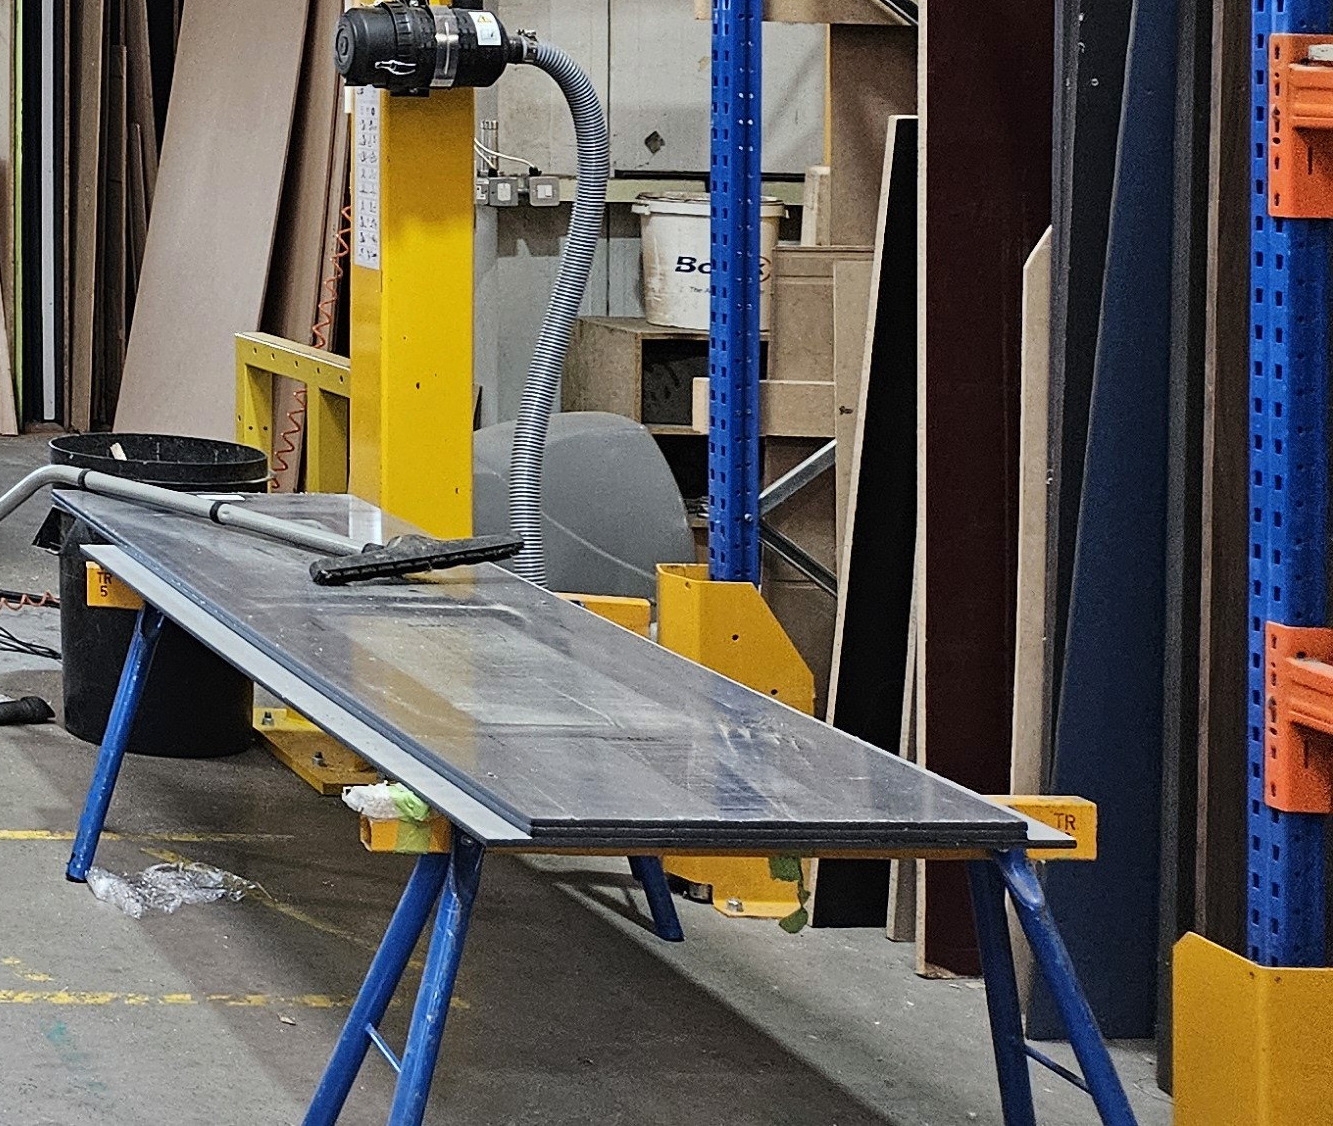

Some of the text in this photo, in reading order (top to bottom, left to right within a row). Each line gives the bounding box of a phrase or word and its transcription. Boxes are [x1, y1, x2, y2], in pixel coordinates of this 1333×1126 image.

[97, 571, 113, 585] TR
[100, 585, 108, 597] 5
[1053, 812, 1076, 831] TR
